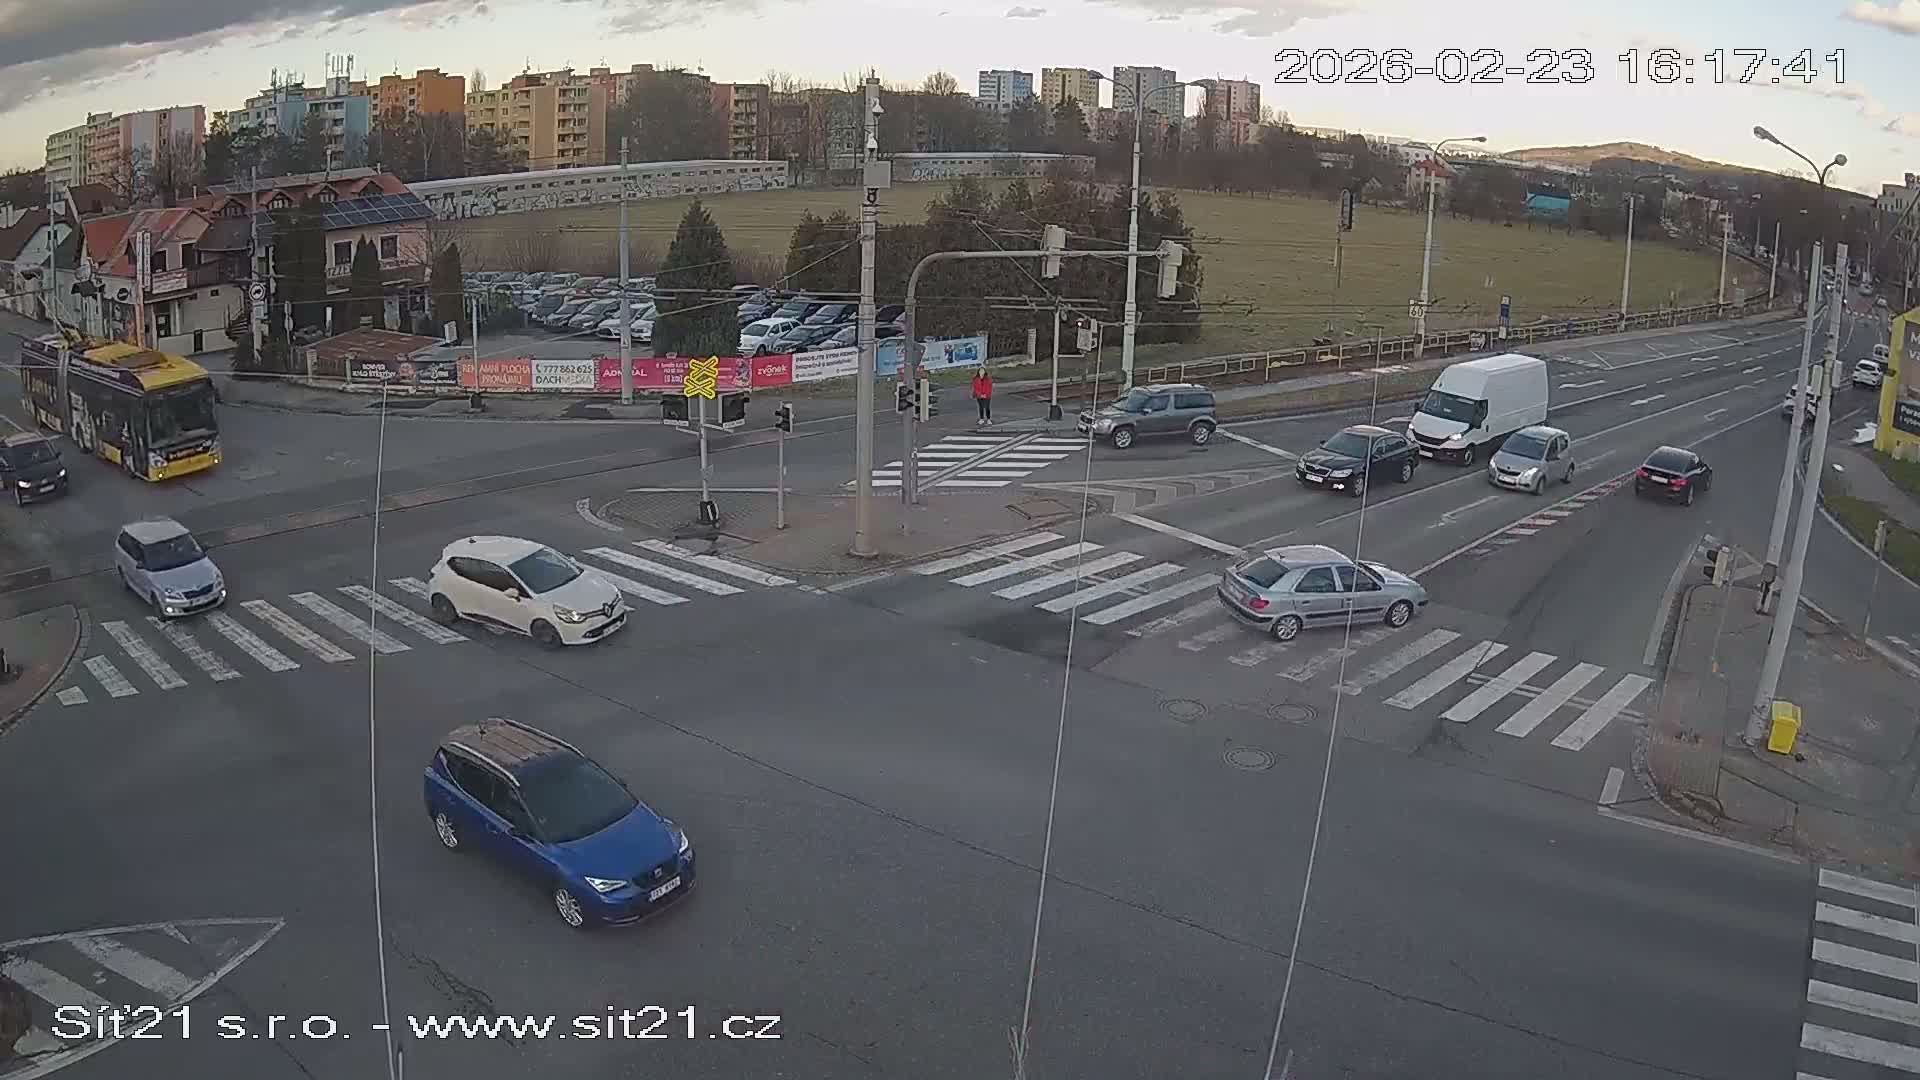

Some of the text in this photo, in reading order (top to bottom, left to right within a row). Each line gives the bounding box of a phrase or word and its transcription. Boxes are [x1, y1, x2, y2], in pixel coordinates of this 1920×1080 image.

[1411, 307, 1423, 317] 60
[501, 364, 531, 374] PLOCHA
[543, 365, 592, 373] 777 862 625
